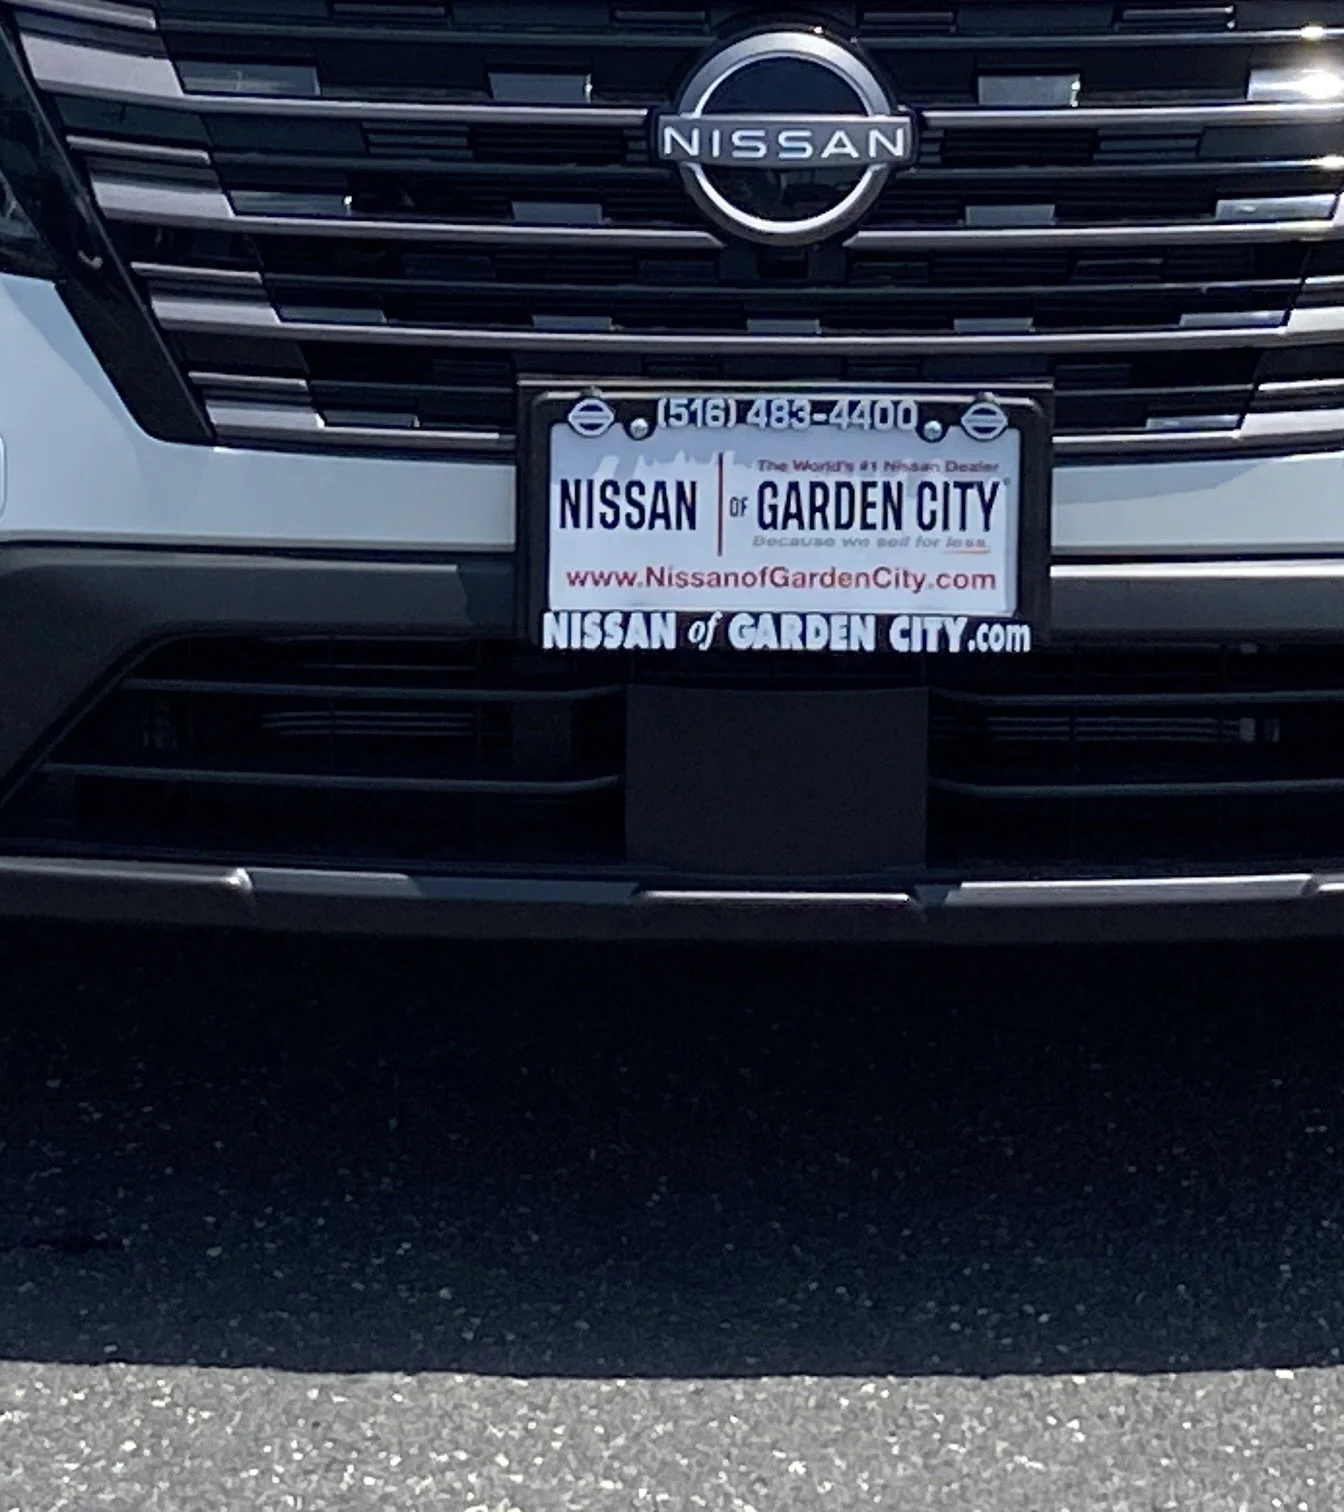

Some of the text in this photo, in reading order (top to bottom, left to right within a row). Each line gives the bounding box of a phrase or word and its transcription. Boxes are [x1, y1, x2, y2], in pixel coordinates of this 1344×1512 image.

[663, 126, 905, 159] NISSAN
[657, 397, 919, 431] (516) 483-4400
[757, 459, 1000, 474] The World's #1 Nissan Dealer
[559, 478, 1001, 532] NISSAN OF GARDEN CITY
[752, 535, 836, 548] Because
[566, 565, 996, 593] www.NissanofGardenCity.com
[542, 610, 1032, 653] NISSAN of GARDEN CITY.com
